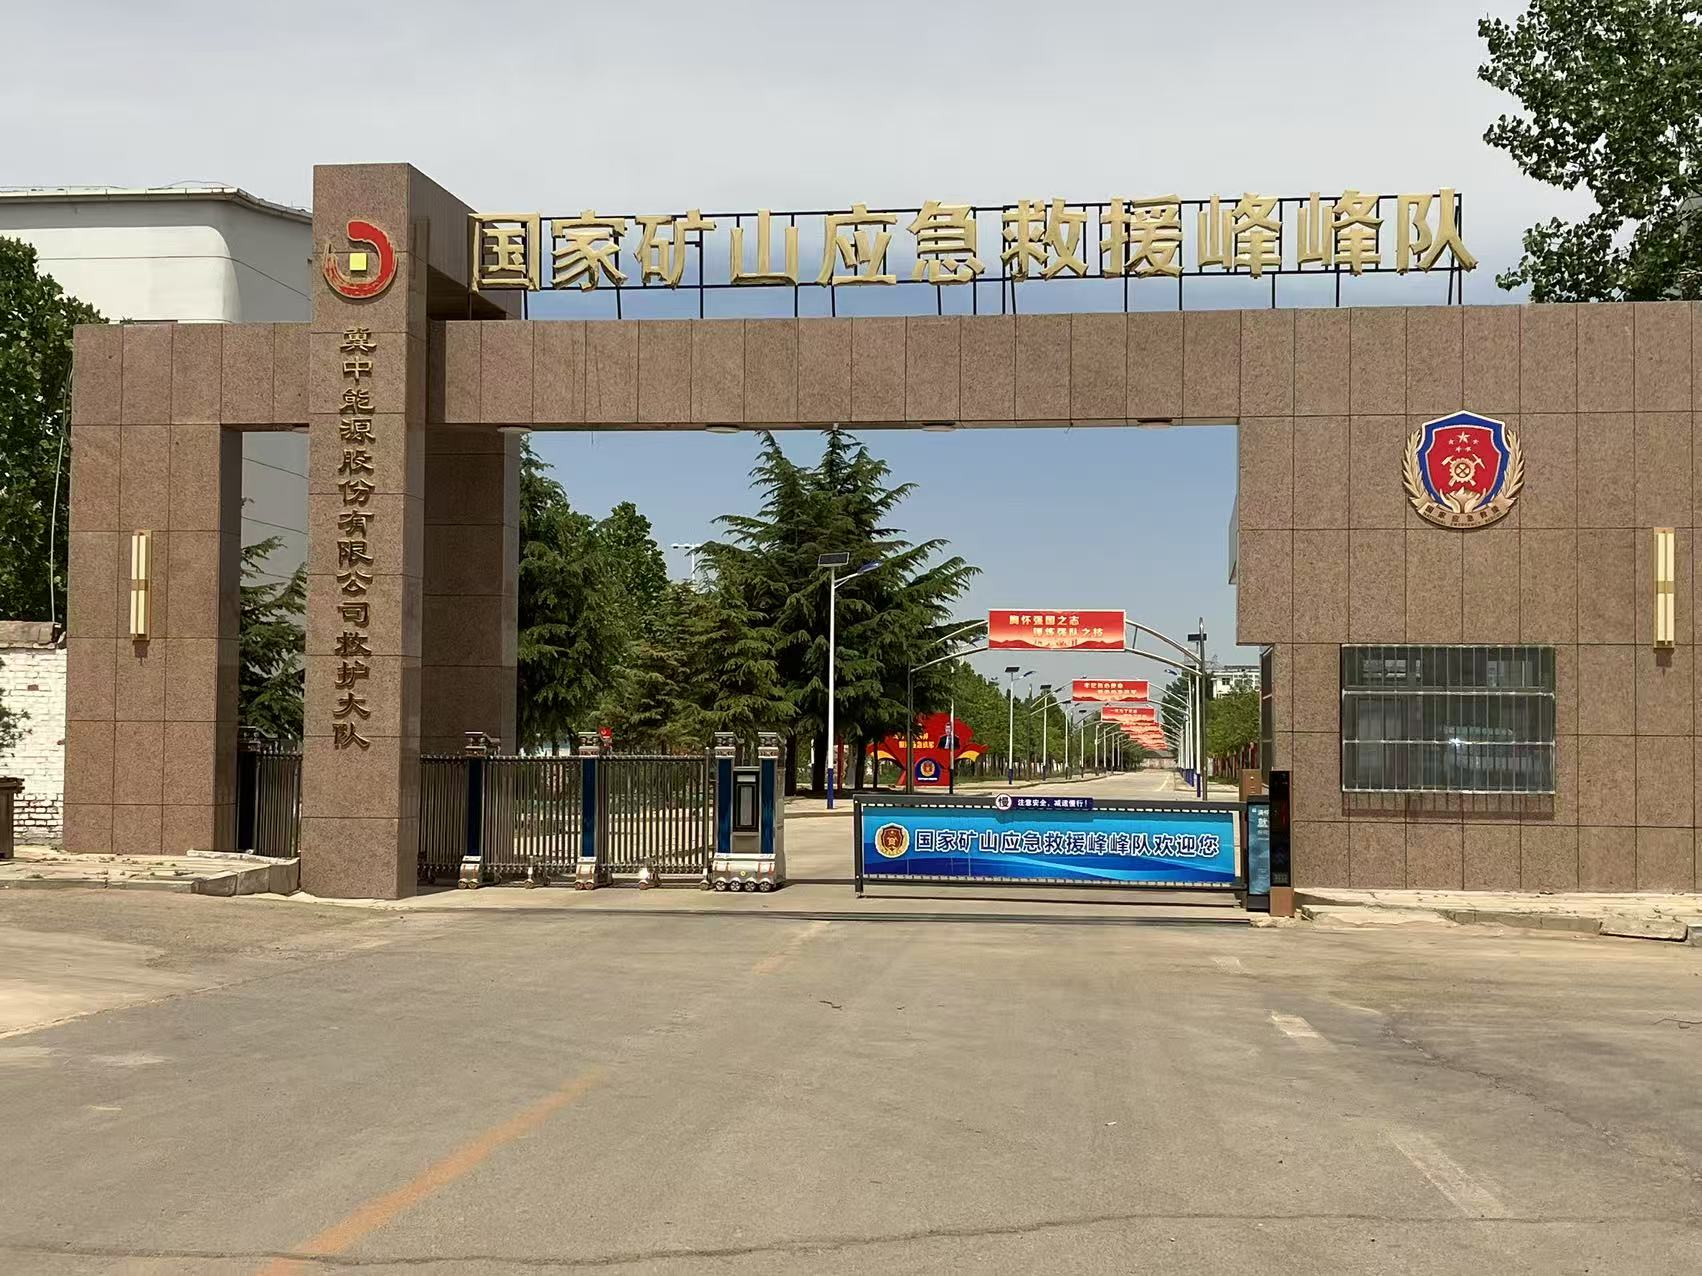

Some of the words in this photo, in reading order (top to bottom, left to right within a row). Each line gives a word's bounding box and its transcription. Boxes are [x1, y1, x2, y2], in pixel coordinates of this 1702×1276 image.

[469, 190, 1477, 291] 国家矿山应急救援峰峰队
[333, 326, 377, 751] 冀中能源股份有限公司救护大队
[1009, 615, 1079, 625] 胸怀强国之志
[915, 829, 1219, 857] 国家矿山应急救援峰峰队欢迎您
